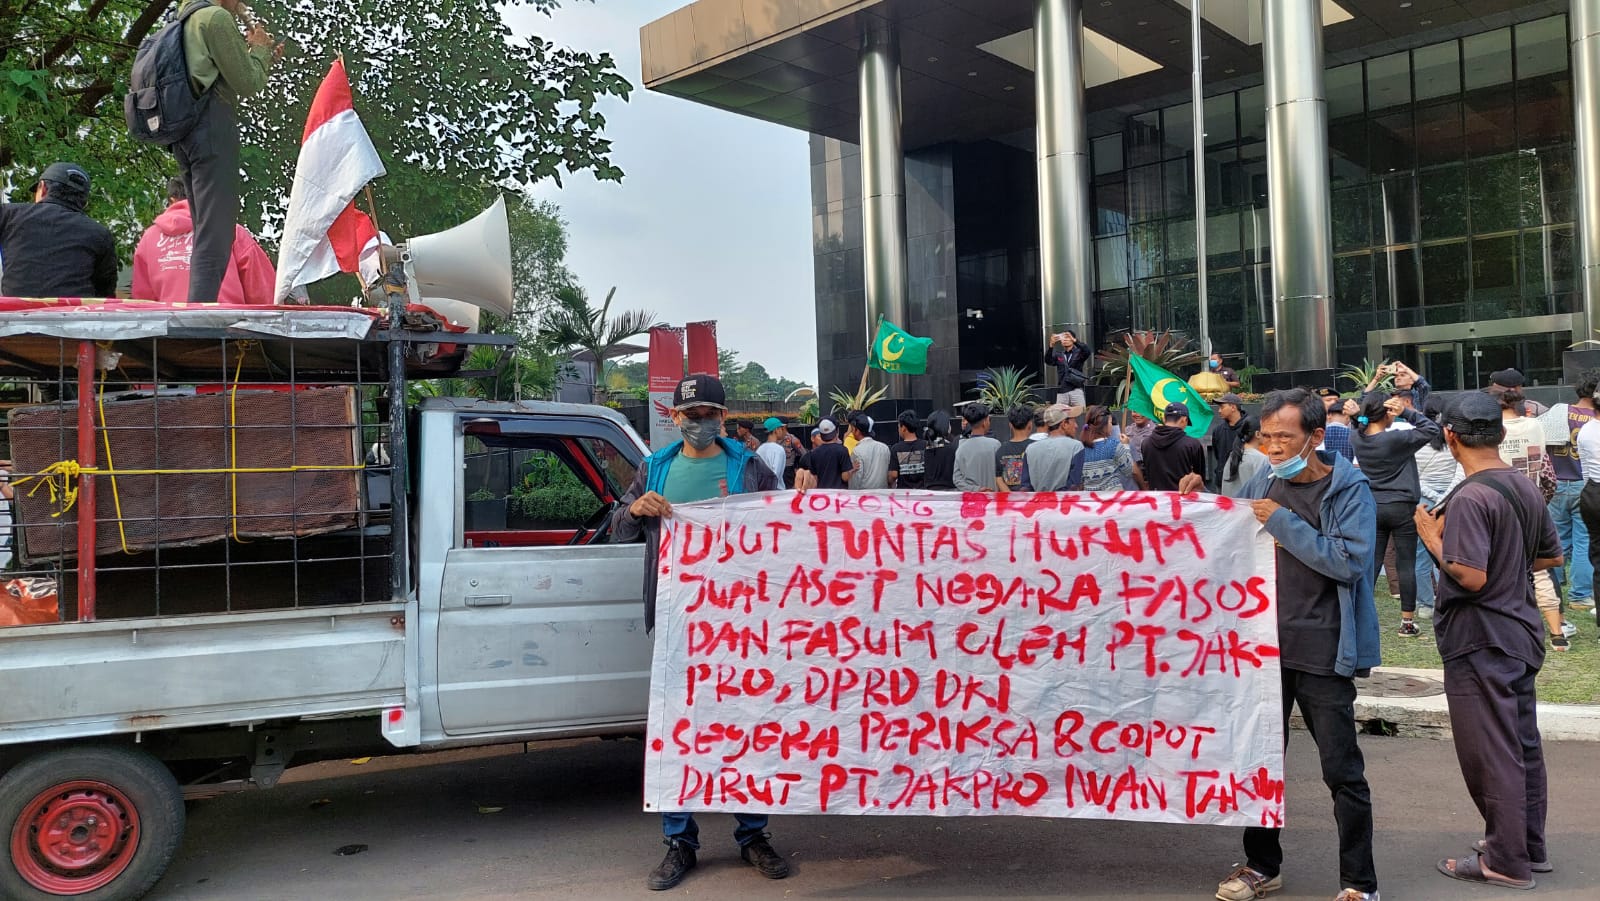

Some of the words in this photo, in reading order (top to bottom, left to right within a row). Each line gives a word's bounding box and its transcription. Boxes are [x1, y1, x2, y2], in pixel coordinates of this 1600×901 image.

[809, 518, 987, 567] TUNTAS
[1009, 517, 1206, 565] HUKUM
[679, 571, 770, 614] JUAL
[778, 564, 898, 613] ASET
[1117, 571, 1270, 623] FASOS
[687, 619, 769, 660] DAN
[780, 616, 937, 663] FASUM
[804, 666, 920, 711] DPRD
[935, 669, 1011, 713] DKI
[859, 711, 1039, 760] PERIKSA
[678, 764, 802, 806] DIRUT
[1065, 763, 1168, 814] IWAN
